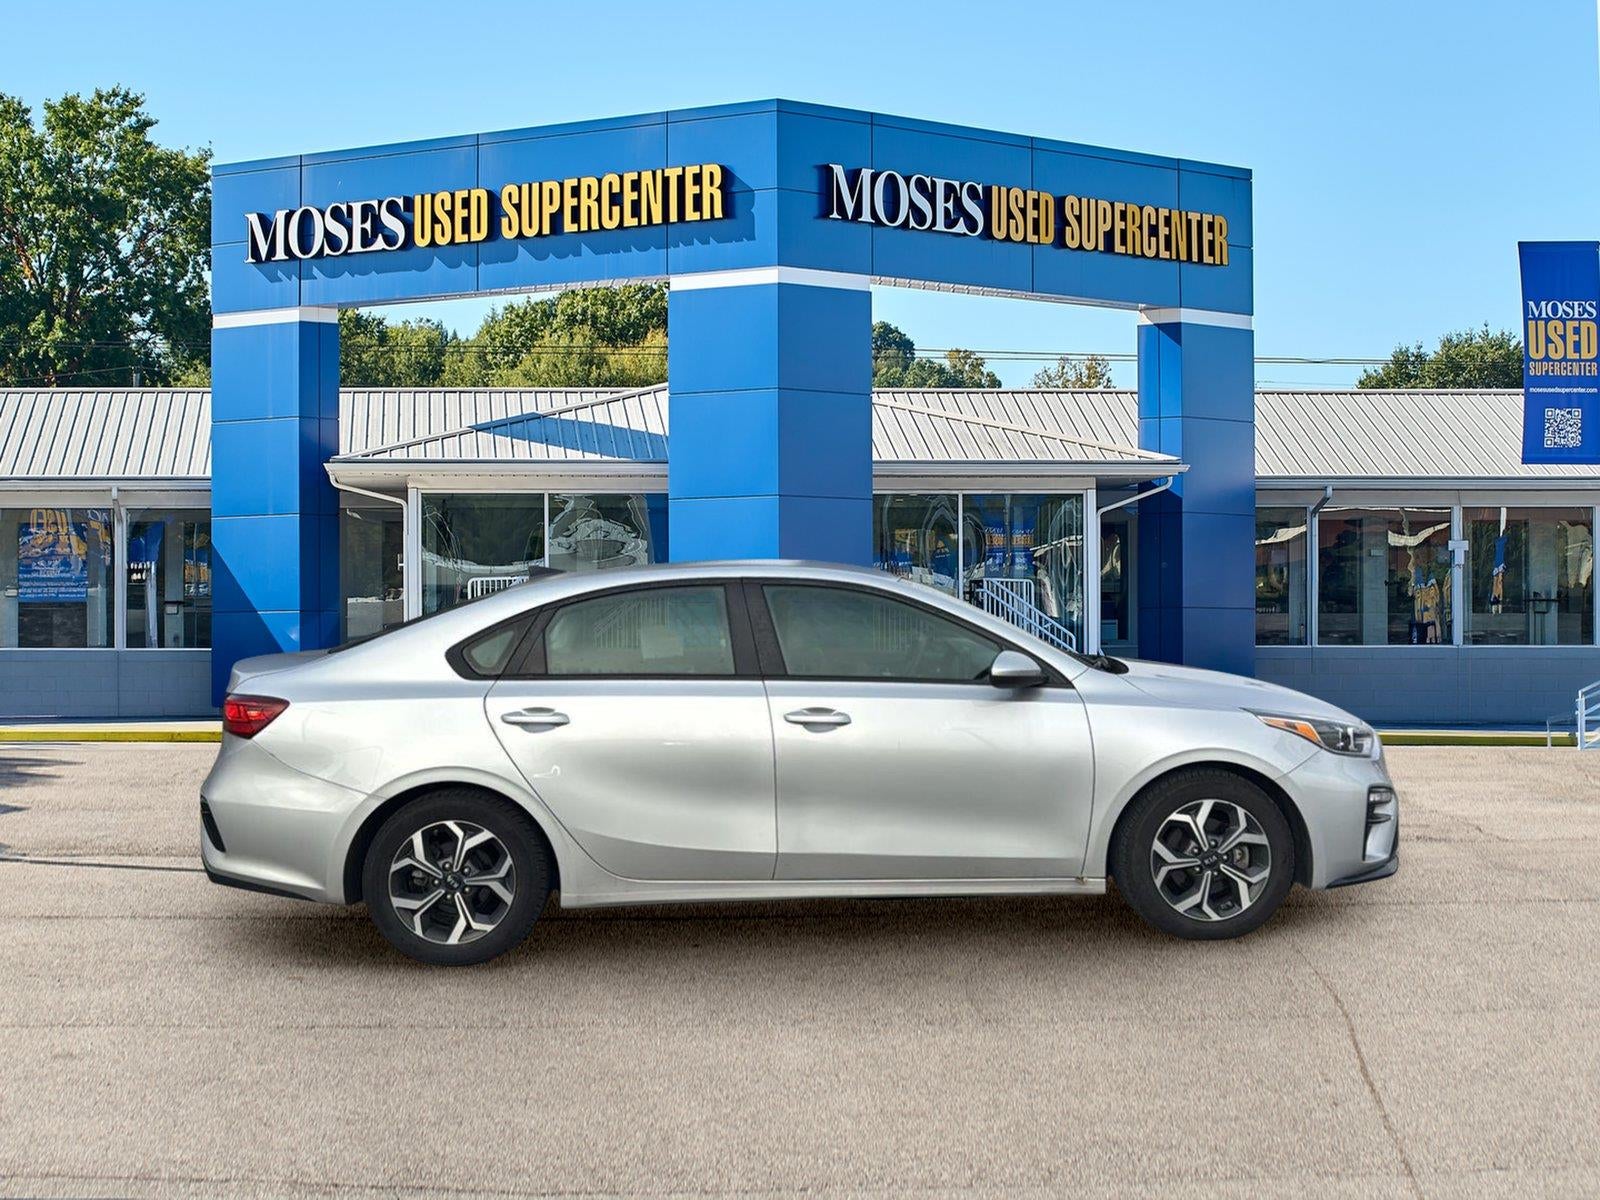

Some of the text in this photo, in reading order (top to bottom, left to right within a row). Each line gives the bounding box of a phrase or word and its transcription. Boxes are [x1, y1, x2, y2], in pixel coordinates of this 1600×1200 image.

[245, 163, 724, 264] MOSES USED SUPERCENTER
[828, 163, 1229, 266] MOSES USED SUPERCENTER
[1528, 301, 1597, 319] MOSES
[1528, 320, 1598, 360] USED
[1529, 361, 1598, 376] SUPERCENTER
